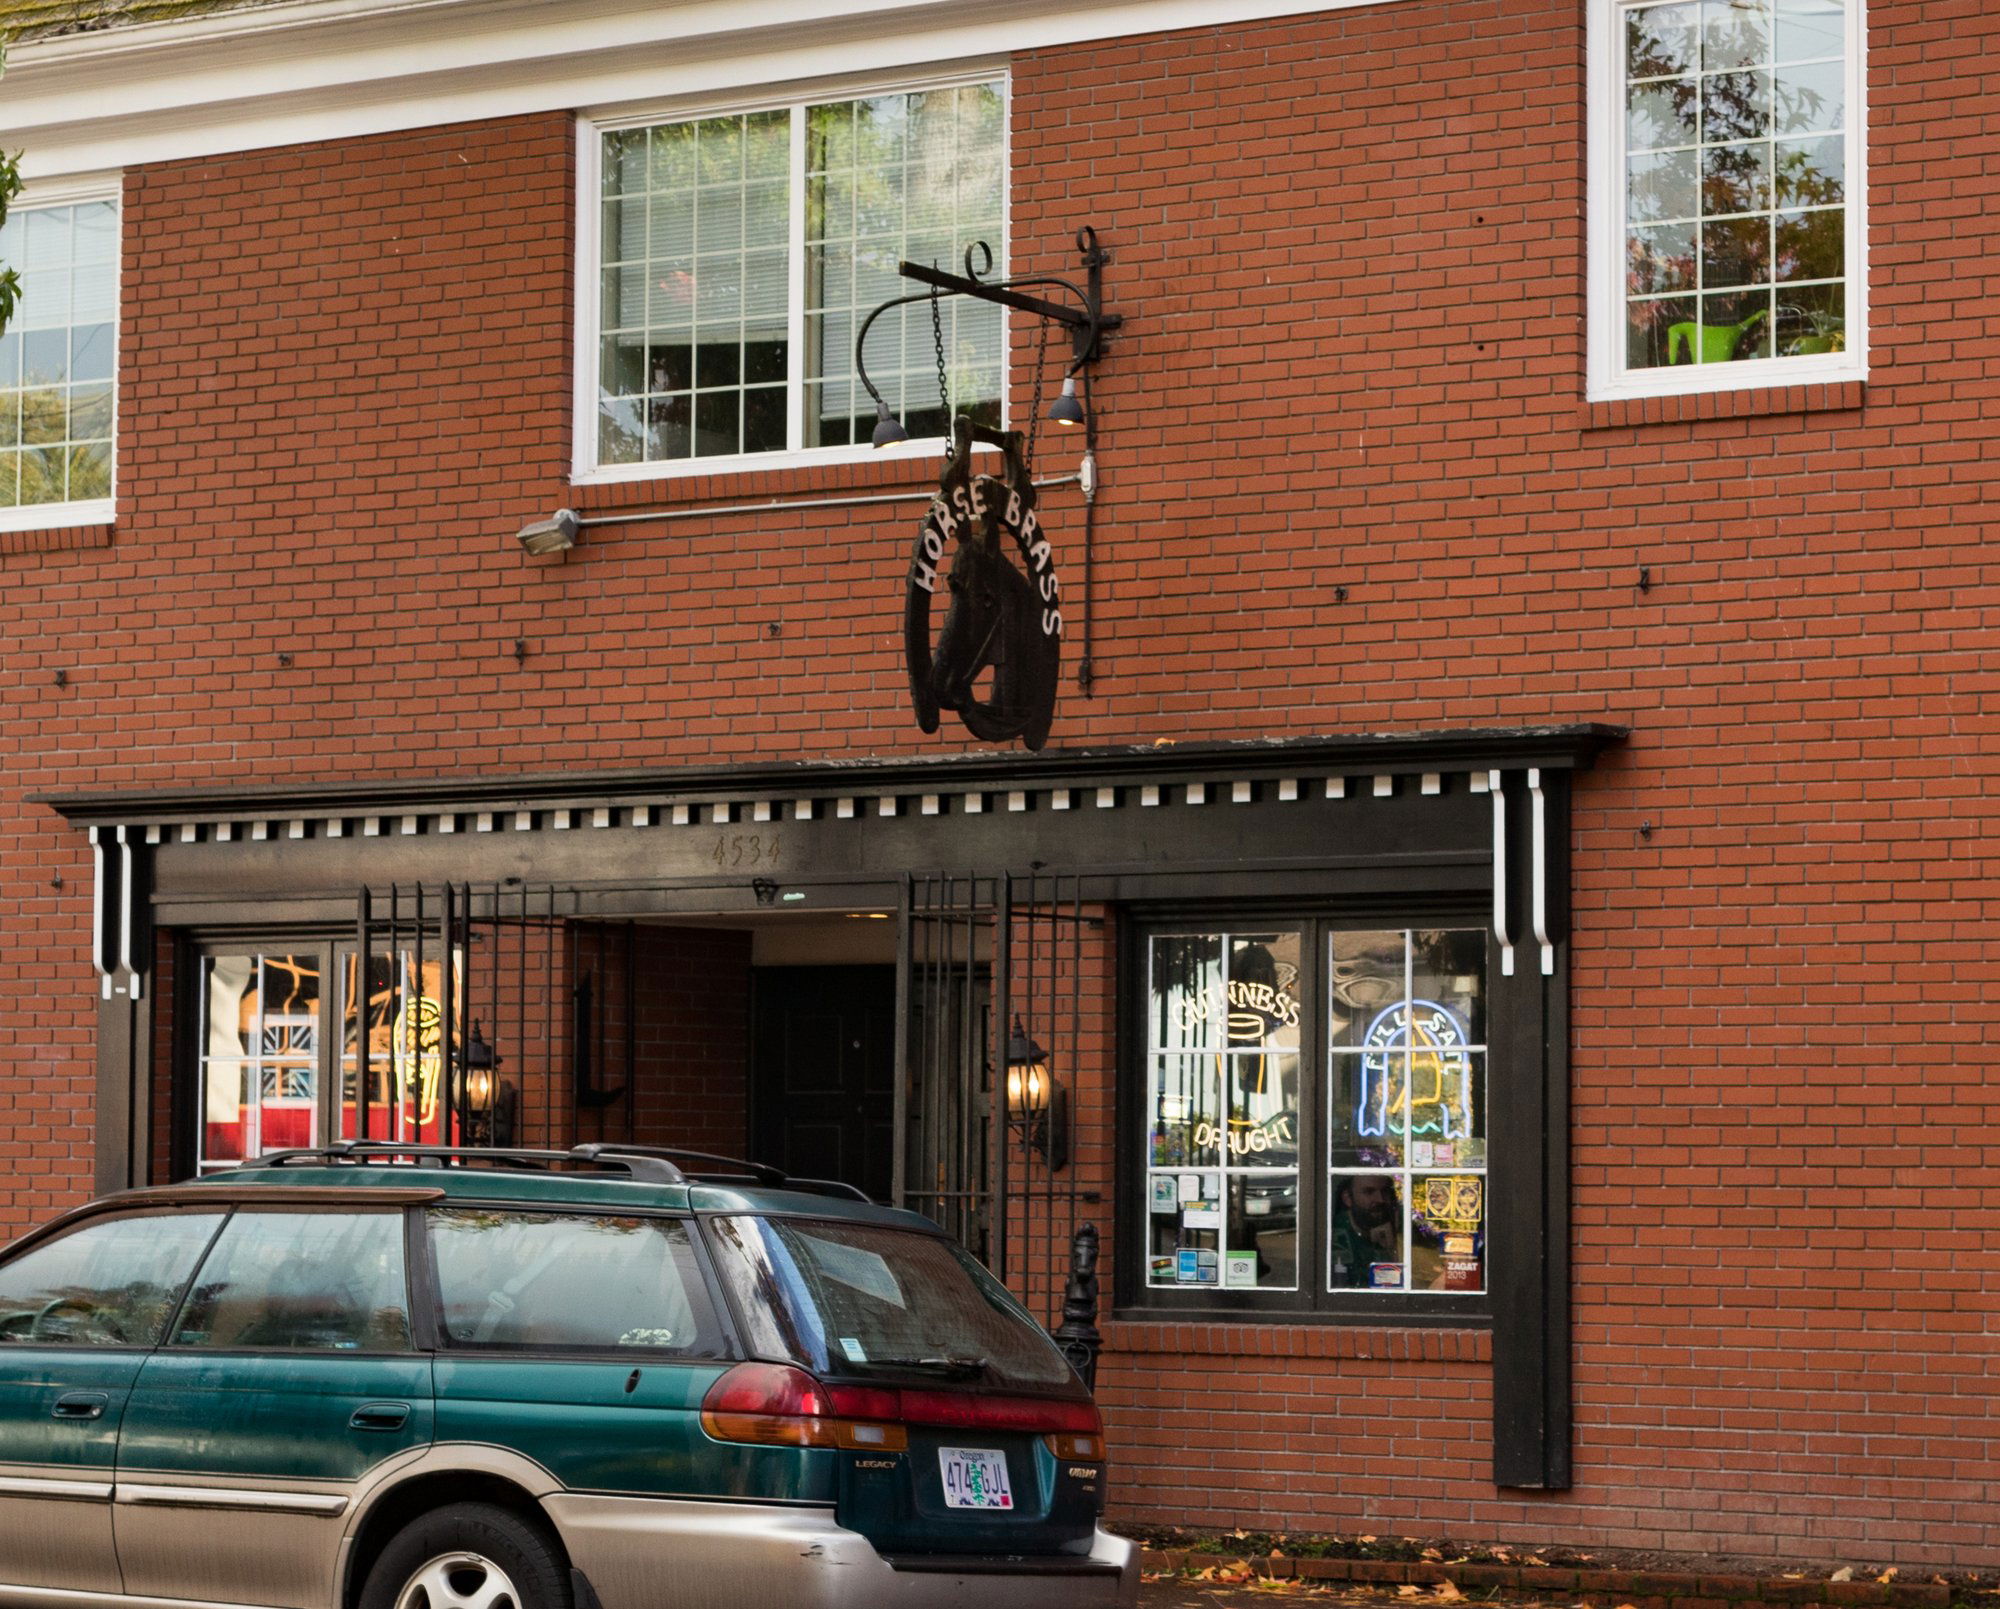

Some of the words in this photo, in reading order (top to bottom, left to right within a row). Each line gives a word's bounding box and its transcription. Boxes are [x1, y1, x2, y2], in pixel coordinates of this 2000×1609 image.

[915, 479, 987, 592] HORSE
[1005, 493, 1062, 635] BRASS
[712, 834, 780, 865] 4534
[1172, 981, 1300, 1028] GUINNESS
[1428, 1011, 1462, 1075] SAIL
[1195, 1116, 1292, 1155] DRAUGHT
[1447, 1262, 1478, 1270] ZAGAT
[1447, 1271, 1467, 1280] 2013
[855, 1460, 896, 1469] LEGACY
[960, 1450, 985, 1463] Oregon
[947, 1462, 973, 1494] 474
[981, 1463, 1008, 1494] GJL
